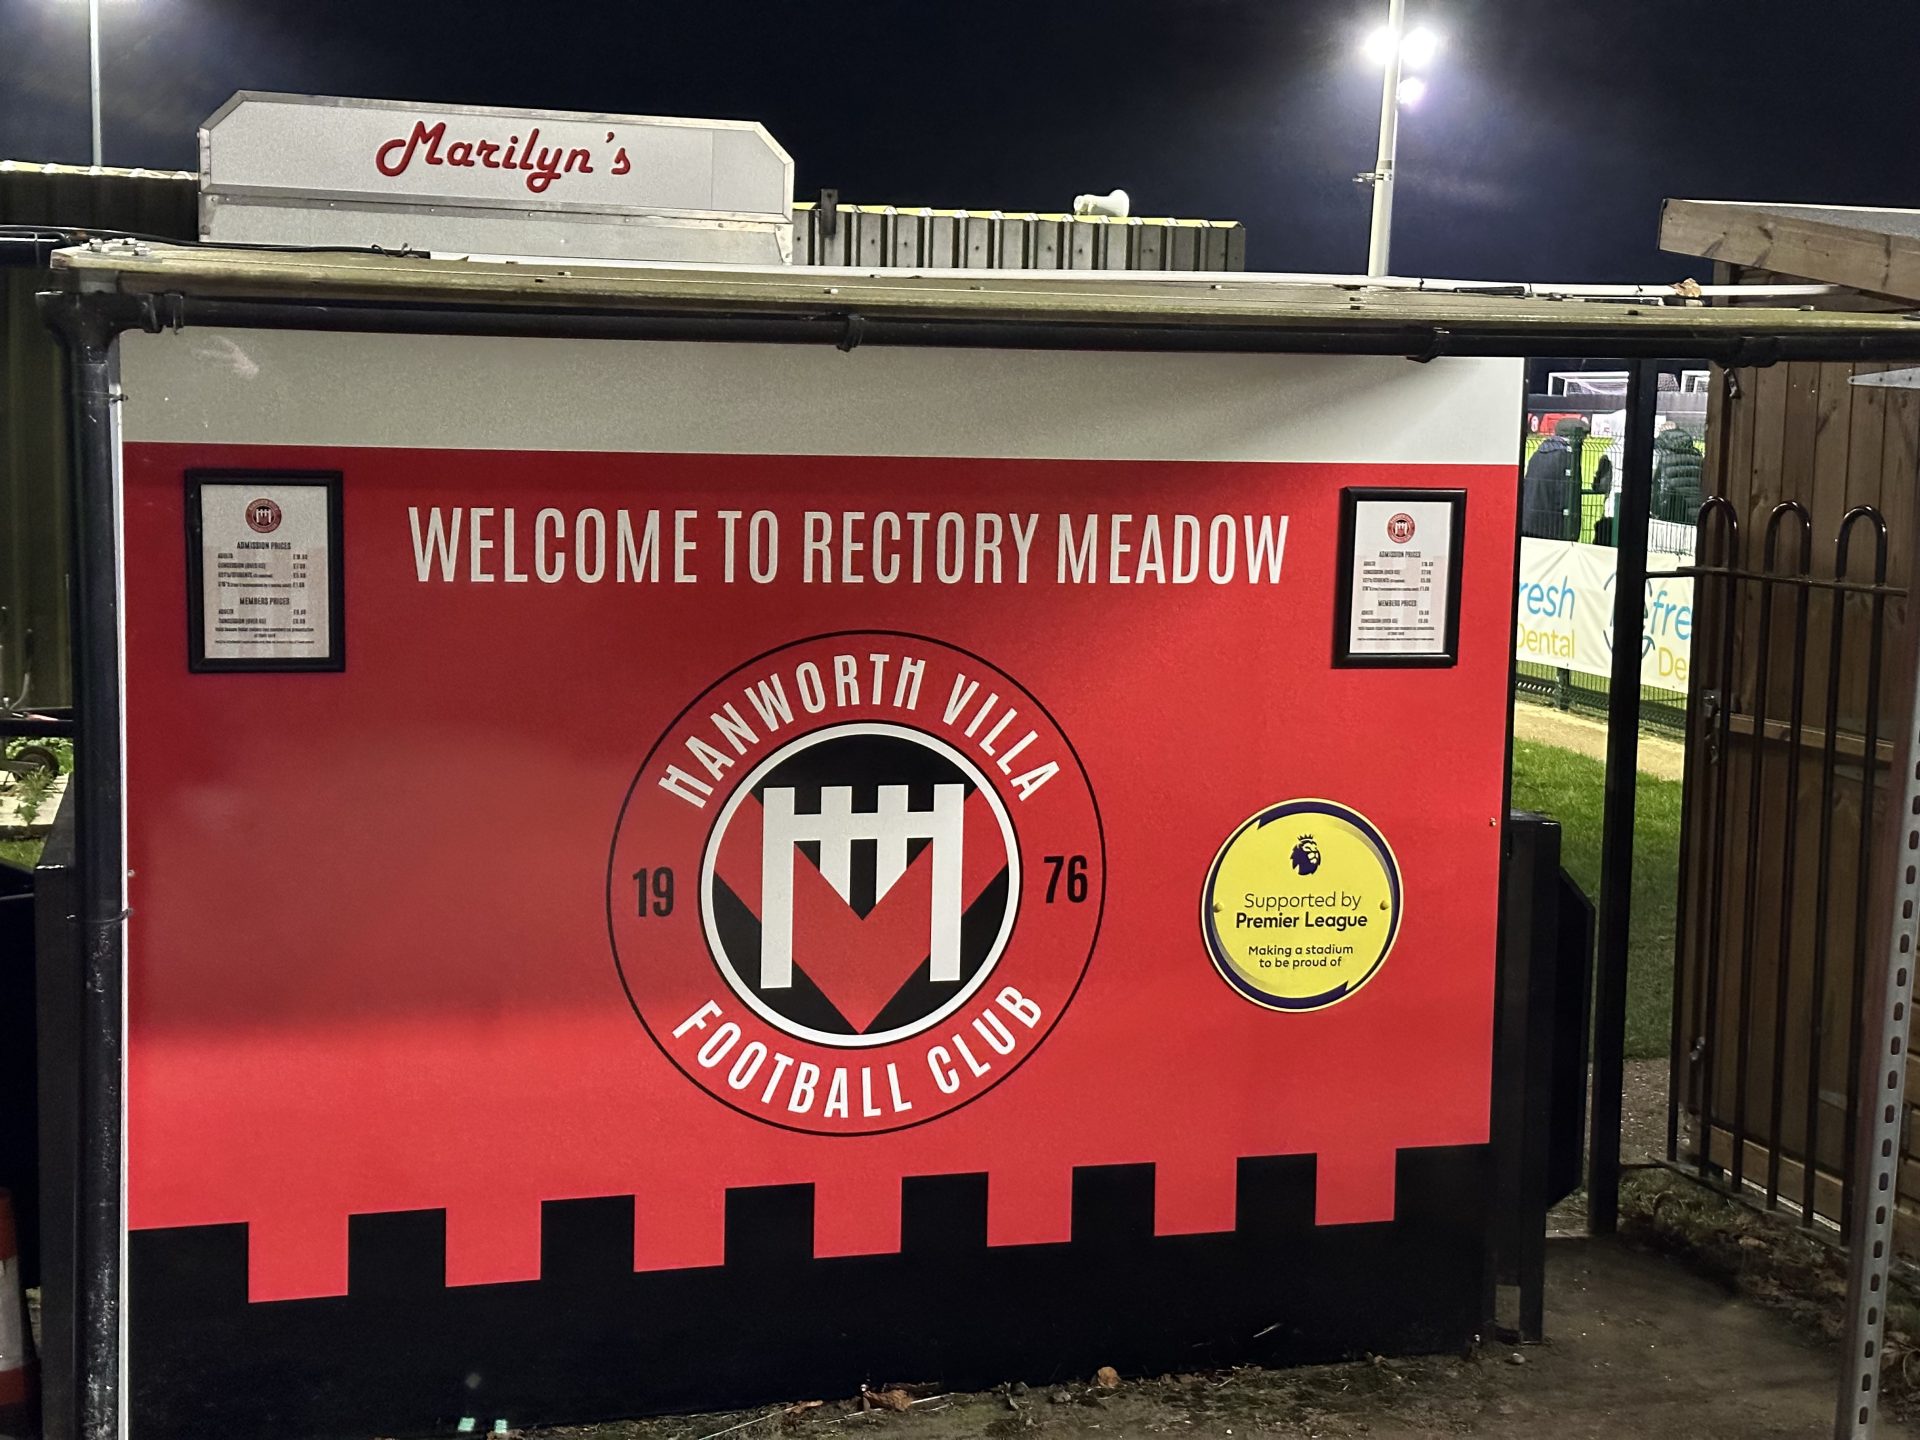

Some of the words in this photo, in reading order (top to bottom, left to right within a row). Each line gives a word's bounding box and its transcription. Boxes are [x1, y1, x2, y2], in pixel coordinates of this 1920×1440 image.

[376, 121, 631, 193] Marilyn's
[408, 507, 698, 584] WELCOME
[717, 510, 779, 584] TO
[803, 511, 1039, 585] RECTORY
[1057, 513, 1289, 585] MEADOW
[657, 653, 926, 809] HANWORTH
[942, 673, 1061, 802] VILLA
[632, 866, 675, 918] 19
[1043, 855, 1089, 905] 76
[1244, 891, 1336, 911] Supported
[1341, 891, 1362, 910] by
[1235, 912, 1300, 929] Premier
[1304, 911, 1368, 931] League
[1248, 945, 1292, 957] Making
[1295, 947, 1303, 956] a
[1305, 943, 1354, 956] stadium
[1259, 957, 1272, 968] to
[1274, 956, 1290, 968] be
[1292, 956, 1327, 970] proud
[1329, 956, 1343, 967] of
[672, 999, 912, 1119] FOOTBALL
[926, 985, 1042, 1095] CLUB
